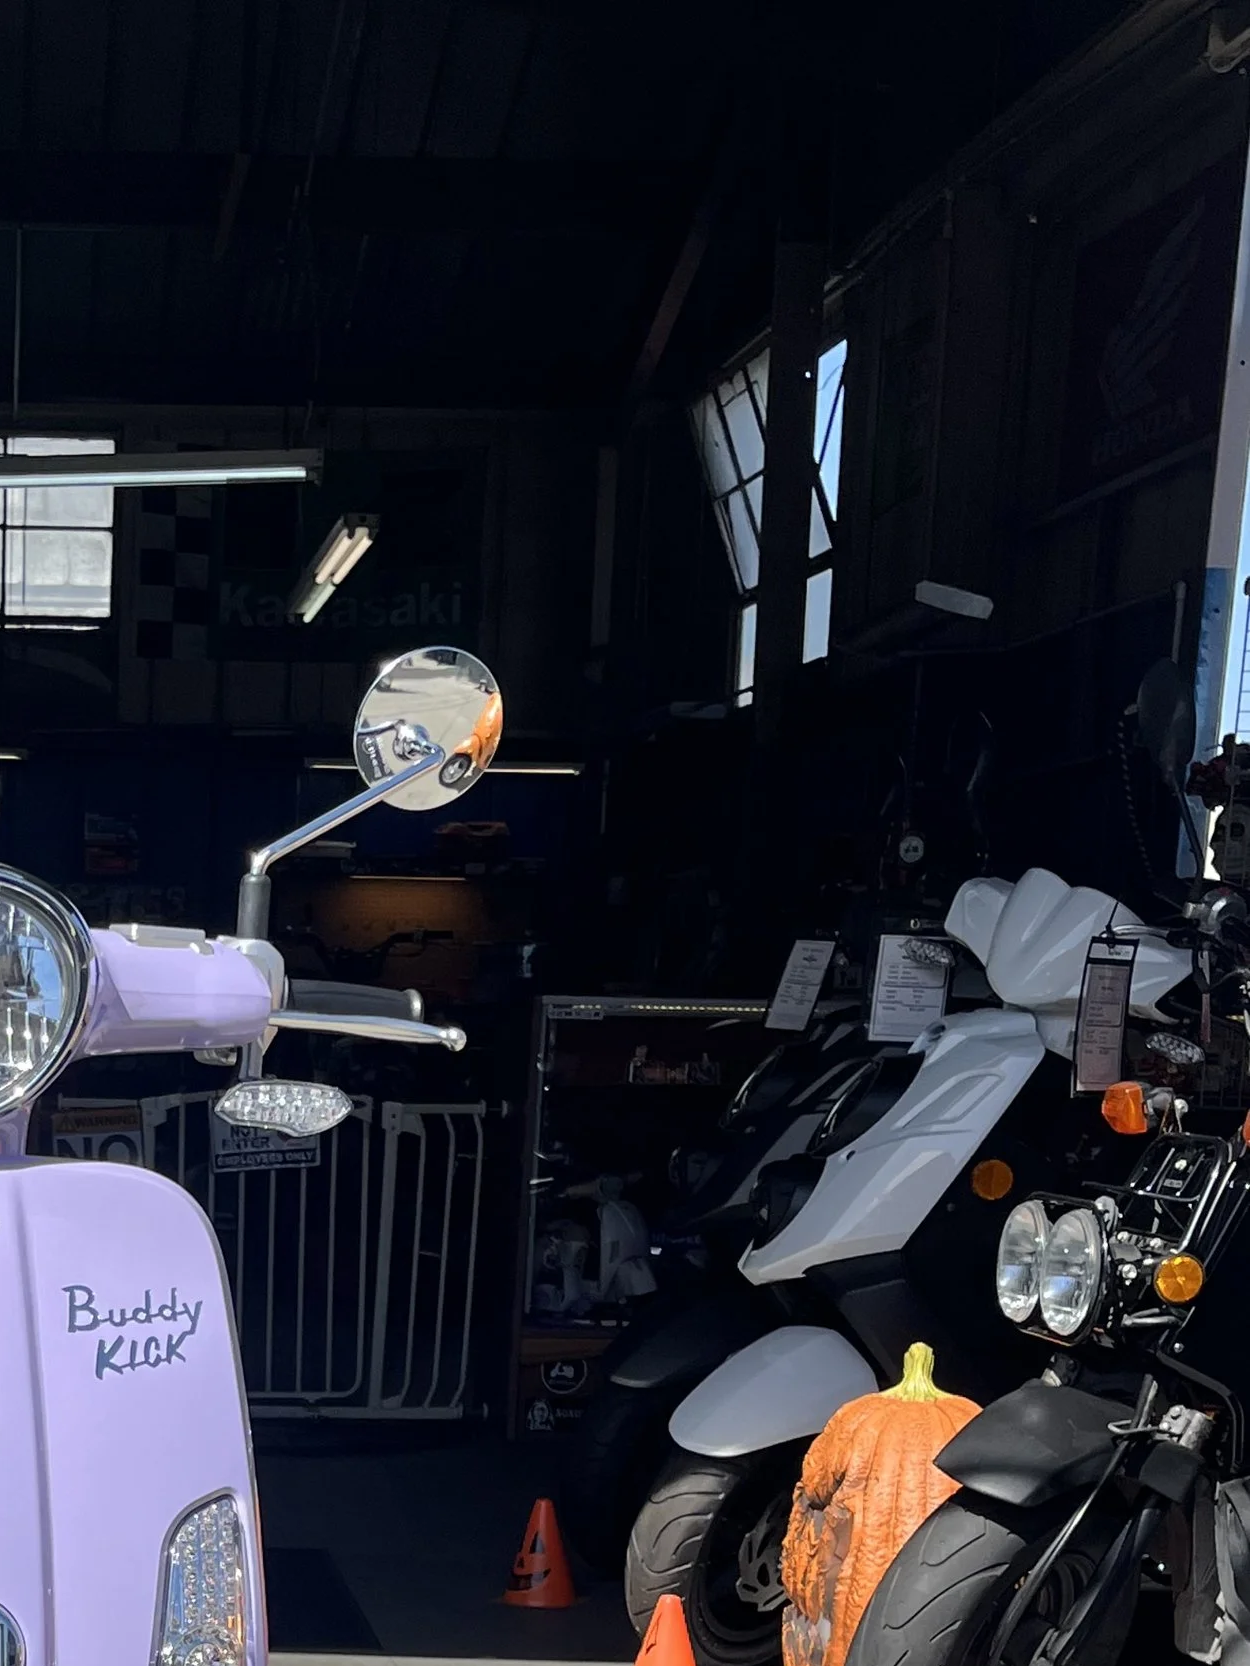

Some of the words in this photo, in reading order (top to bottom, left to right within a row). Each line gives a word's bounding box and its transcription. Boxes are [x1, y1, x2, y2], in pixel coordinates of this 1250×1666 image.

[219, 581, 462, 628] Kaasaki
[222, 1137, 270, 1150] ENTER
[285, 1150, 314, 1161] ONLY
[61, 1285, 203, 1335] Buddy
[95, 1333, 187, 1380] KICK
